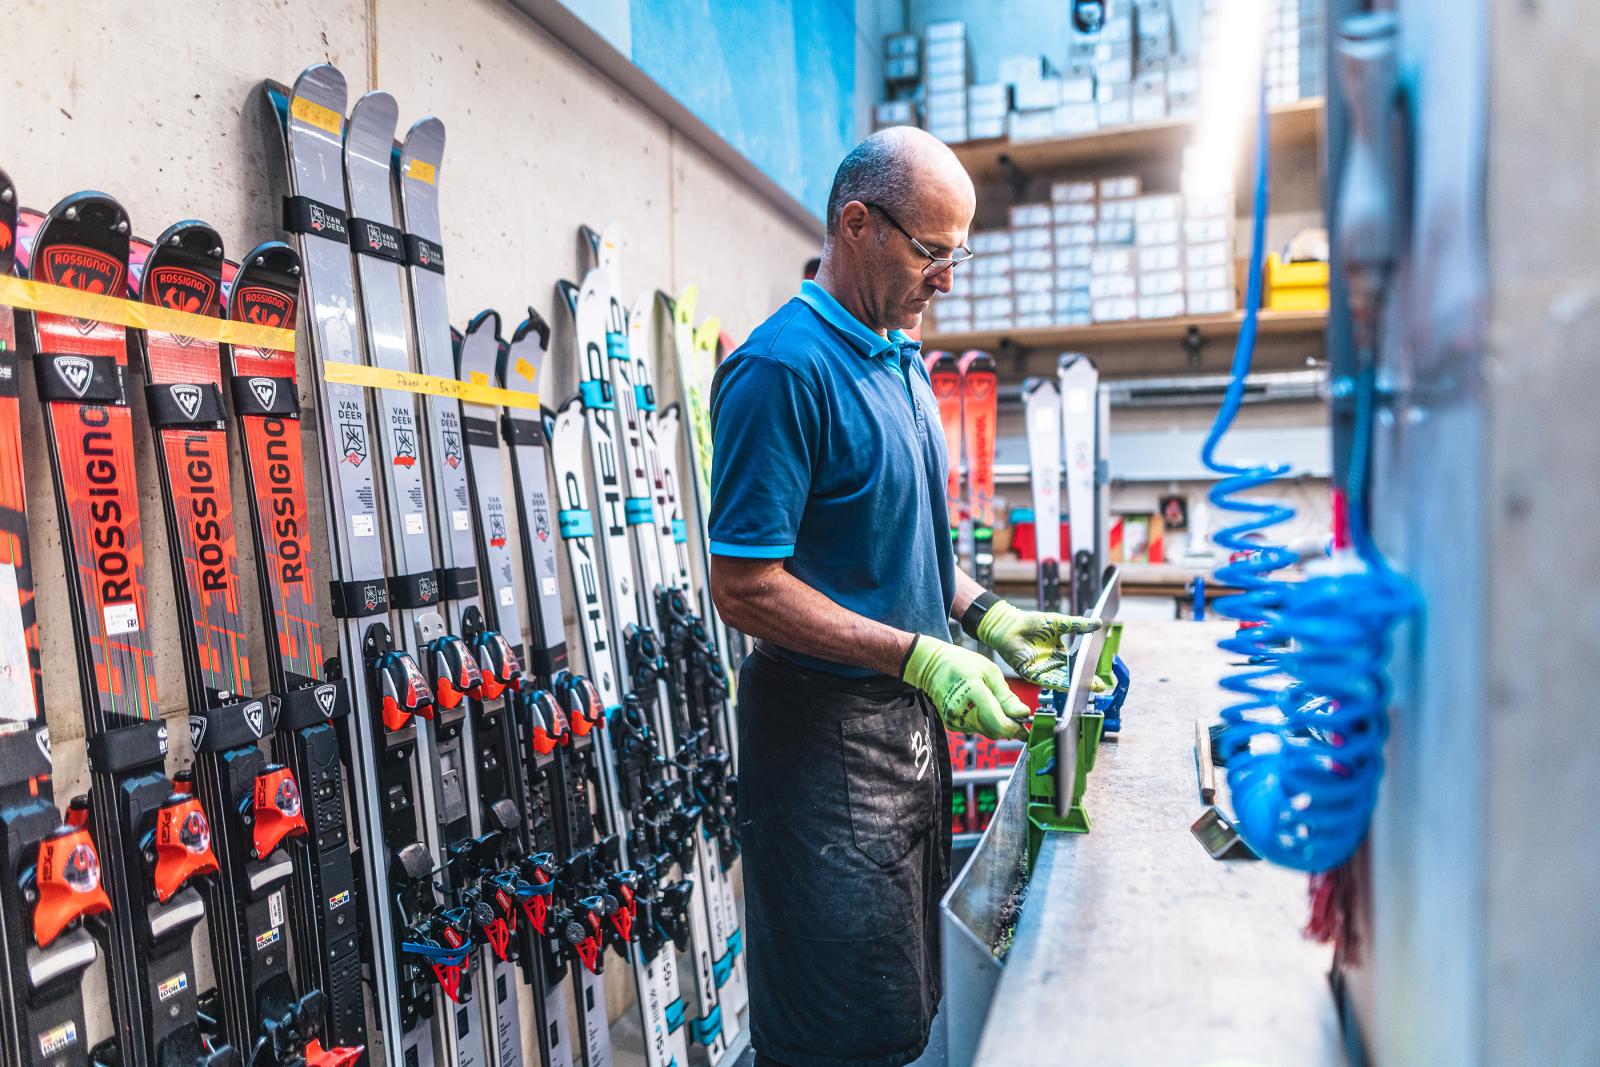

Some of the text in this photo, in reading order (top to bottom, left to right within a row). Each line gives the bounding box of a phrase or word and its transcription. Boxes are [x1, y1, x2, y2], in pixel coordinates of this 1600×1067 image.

[324, 215, 341, 225] VAN
[326, 222, 345, 234] DEER
[381, 232, 395, 242] VAN
[55, 253, 111, 276] ROSSIGNOL
[160, 273, 206, 294] ROSSIGNOL
[246, 293, 286, 310] ROSSIGNOL
[339, 401, 359, 411] VAN
[392, 407, 409, 416] VAN
[338, 410, 362, 420] DEER
[391, 416, 412, 425] DEER
[441, 411, 455, 419] VAN
[440, 418, 458, 428] DEER
[80, 403, 133, 603] ROSSIGNO
[263, 416, 304, 584] ROSSIGNO
[184, 434, 228, 591] ROSSIGN
[330, 897, 344, 908] LOOK
[257, 937, 273, 948] LOOK
[160, 985, 179, 998] LOOK
